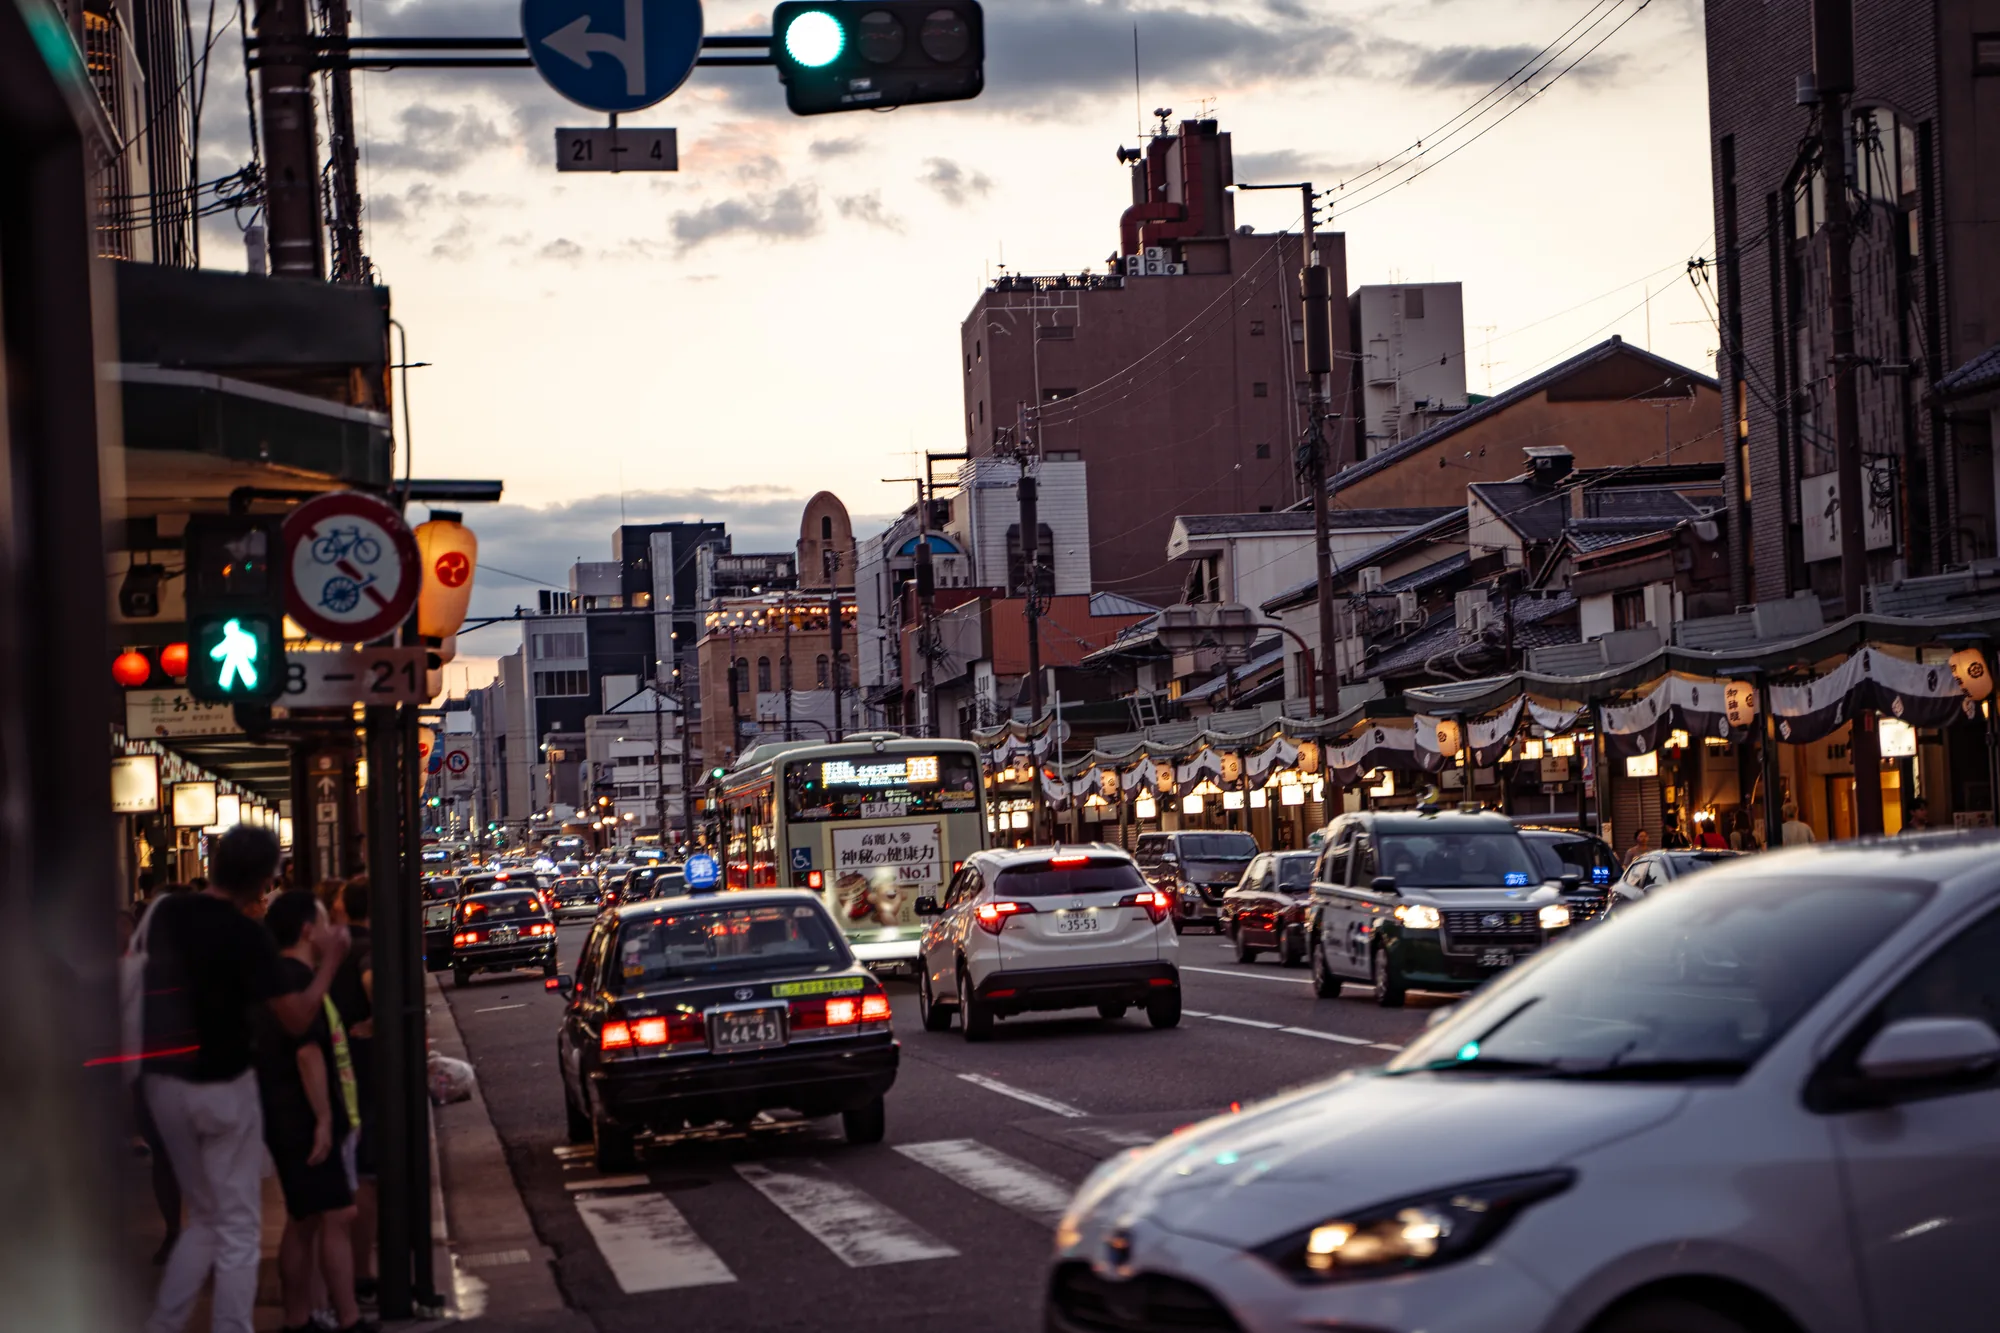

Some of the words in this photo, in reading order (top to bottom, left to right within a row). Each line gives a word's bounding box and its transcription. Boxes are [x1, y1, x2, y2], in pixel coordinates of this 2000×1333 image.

[572, 138, 592, 161] 21
[650, 139, 663, 161] 4
[371, 659, 417, 693] 21
[908, 758, 937, 781] 203
[865, 803, 902, 813] 市バス
[861, 831, 911, 846] 高麗人参
[841, 844, 935, 866] 神秘の健康力
[899, 864, 931, 880] No.1
[1067, 918, 1097, 930] 35-53
[731, 1023, 776, 1043] 64-43
